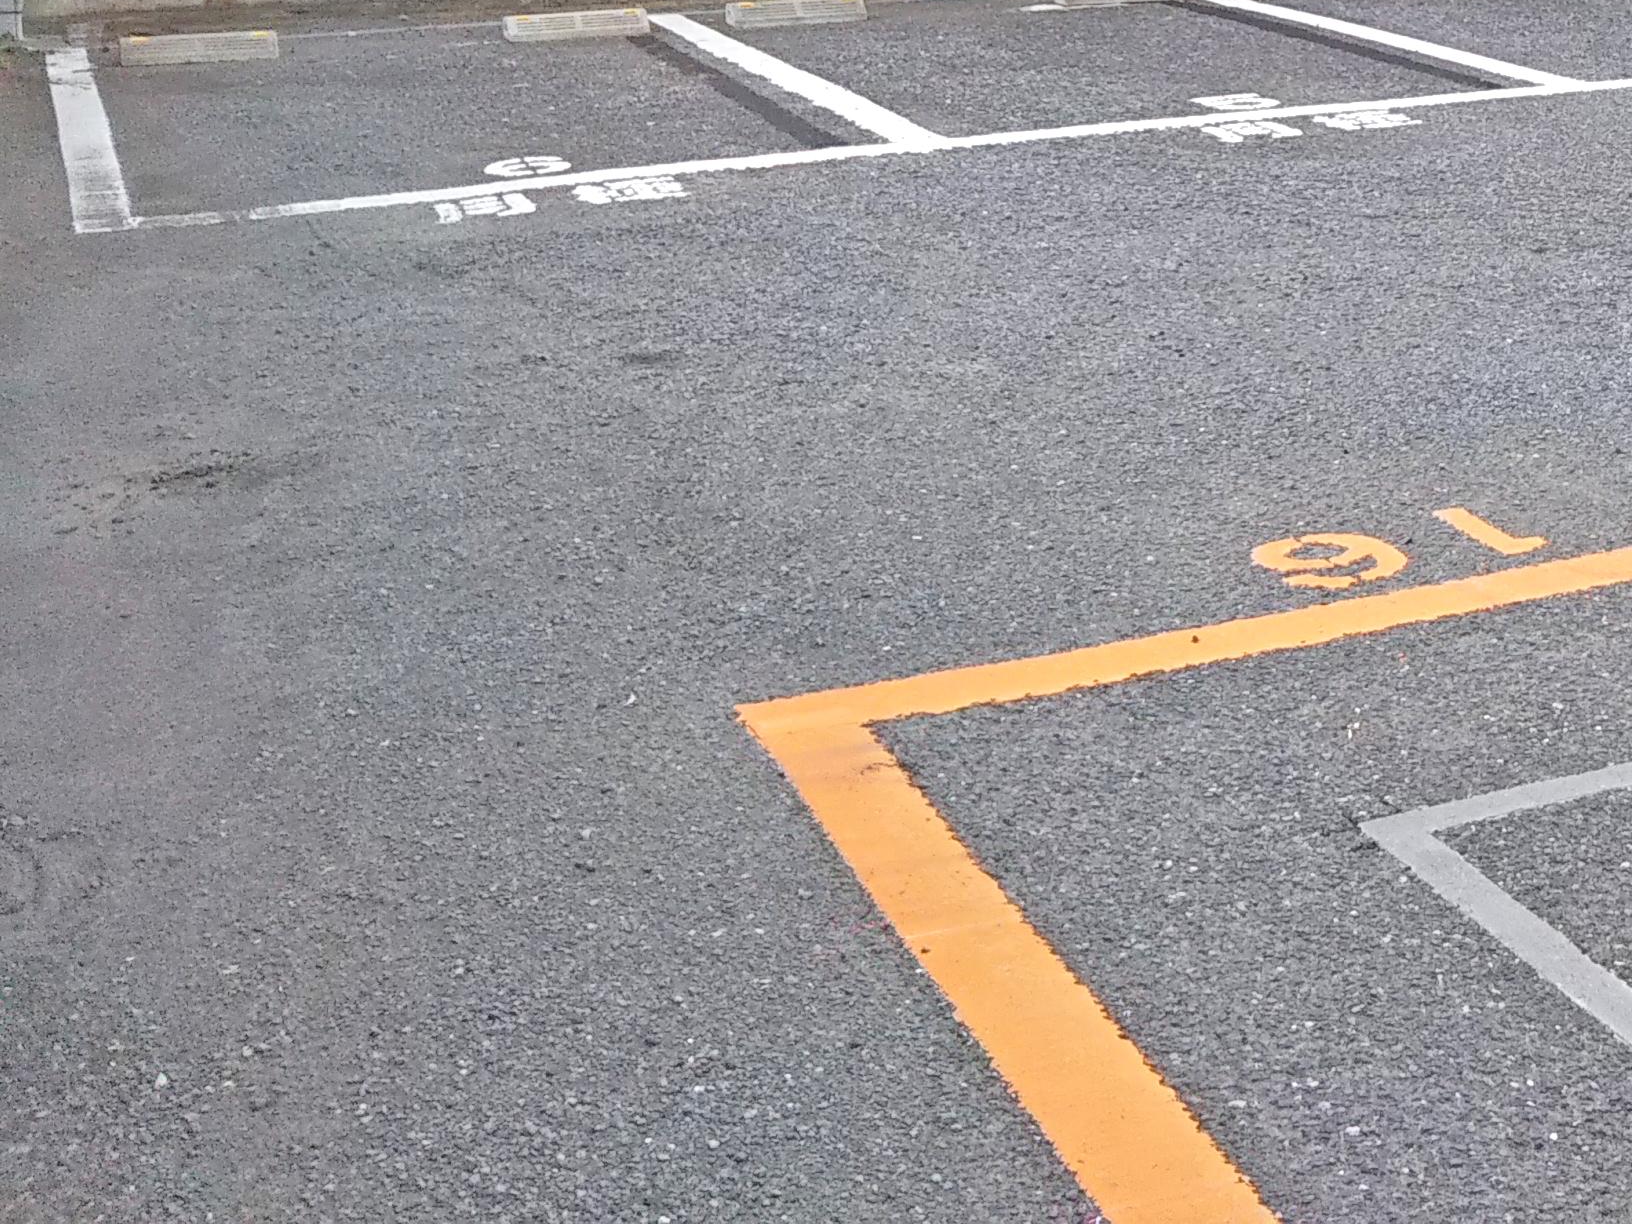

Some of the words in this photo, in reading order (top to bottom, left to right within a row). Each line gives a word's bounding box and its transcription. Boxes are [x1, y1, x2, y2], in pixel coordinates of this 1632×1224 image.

[1188, 92, 1281, 110] 5
[484, 155, 572, 177] 6
[1250, 506, 1549, 590] 16
